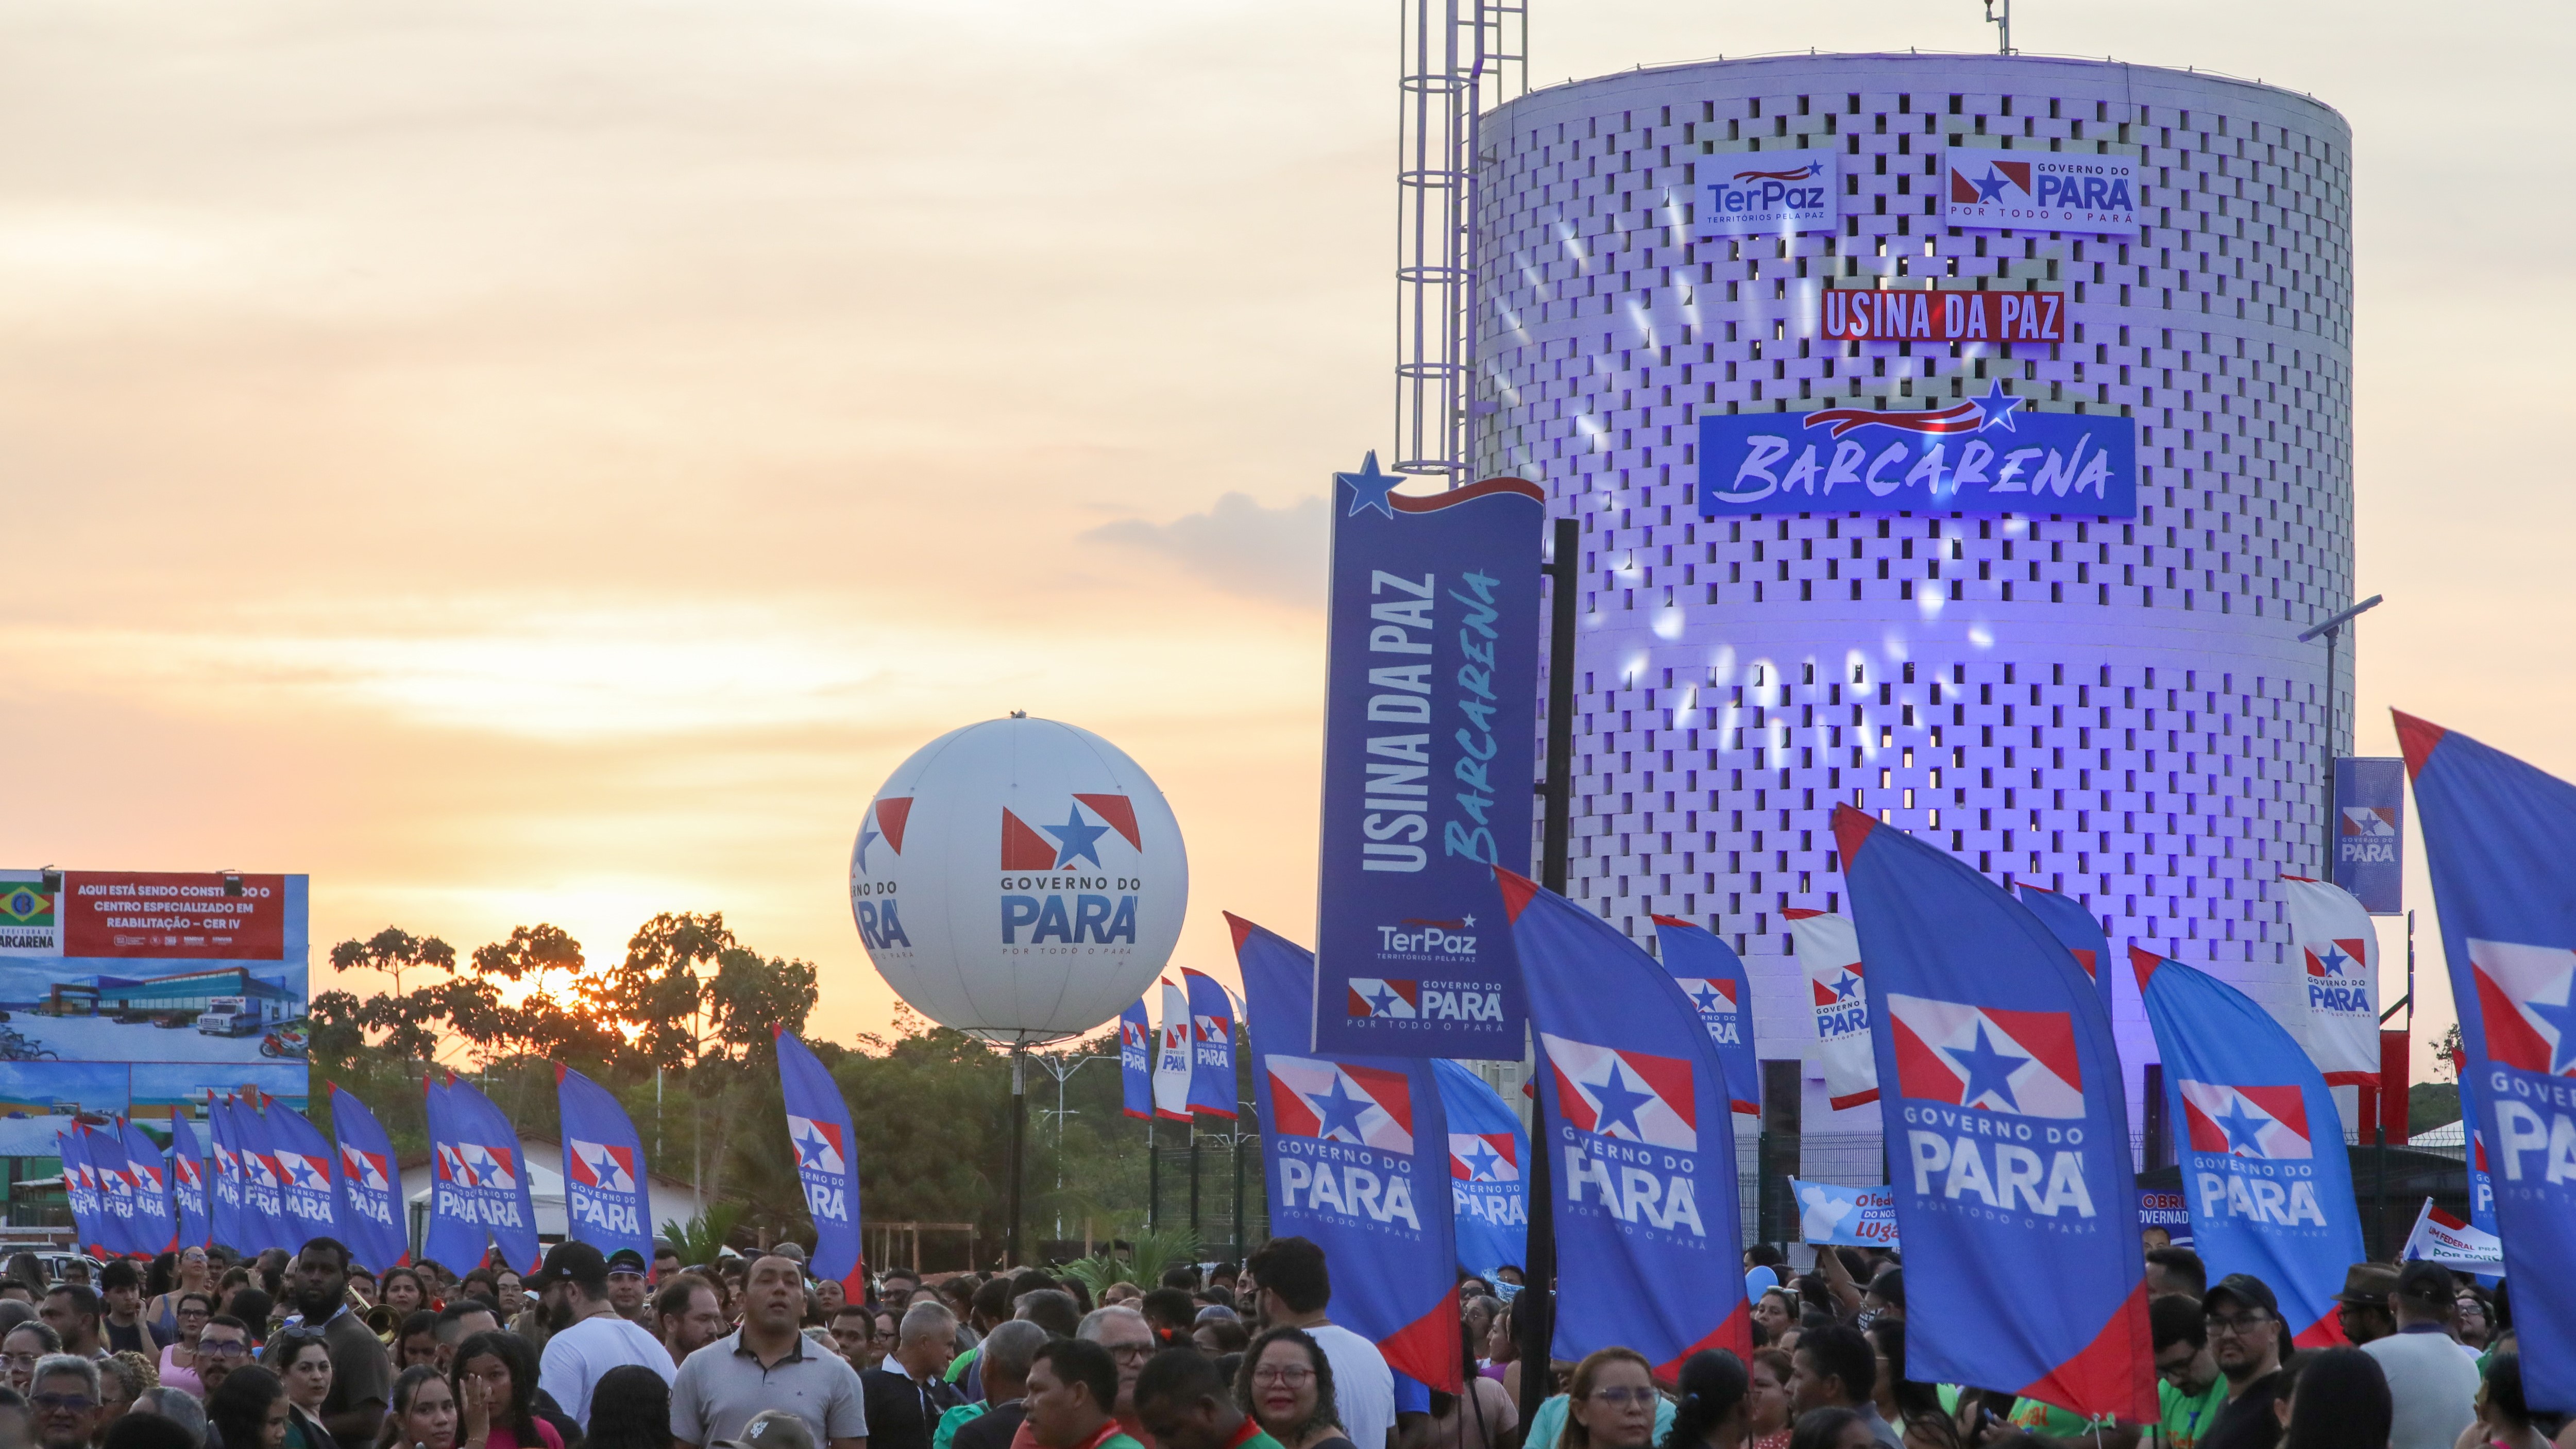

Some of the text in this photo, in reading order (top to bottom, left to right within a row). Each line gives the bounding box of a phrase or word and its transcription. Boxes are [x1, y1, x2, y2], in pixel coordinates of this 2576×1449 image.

[2038, 163, 2103, 174] GOVERNO
[1707, 181, 1824, 212] TerPaz
[2038, 175, 2133, 211] PARÁ
[1707, 214, 1771, 223] TERRITÓRIOS
[1951, 207, 1984, 215] POR
[2000, 209, 2048, 218] TODO
[2088, 213, 2132, 223] PARÁ
[1826, 292, 2059, 340] USINA DA PAZ
[1712, 433, 2114, 504] BARCARENA
[1363, 569, 1434, 872] USINA DA PAZ
[1445, 568, 1500, 881] BARCARENA
[78, 883, 270, 898] AQUI ESTÁ SENDO CONSTDO O
[877, 881, 896, 894] DO
[1001, 877, 1140, 890] GOVERNO DO
[94, 902, 253, 913] CENTRO ESPECIALIZADO EM
[107, 916, 241, 931] REABILITAÇÃO CER IV
[853, 899, 912, 950] RÁ
[1001, 895, 1138, 944] PARÁ
[1378, 926, 1476, 954] TerPaz
[1377, 953, 1432, 961] TERRITÓRIOS
[1423, 981, 1479, 990] GOVERNO
[2308, 976, 2347, 986] GOVERNO
[1422, 991, 1503, 1022] PARÁ
[1817, 1001, 1859, 1014] GOVERNO
[2308, 984, 2370, 1012] PARÁ
[1347, 1020, 1503, 1032] POR TODO O PARÁ
[1707, 1022, 1740, 1044] RÁ
[1904, 1106, 2083, 1144] GOVERNO DO
[1278, 1140, 1411, 1173] GOVERNO DO
[1563, 1126, 1694, 1173] GVERNO DO
[800, 1171, 844, 1186] ERNO DO
[1907, 1130, 2097, 1219] PARÁ
[2194, 1157, 2312, 1177] GOVERNO DO
[284, 1186, 314, 1197] VERNO
[571, 1183, 621, 1202] GOVERNO
[801, 1181, 848, 1221] RÁ
[1279, 1158, 1421, 1231] PARÁ
[1856, 1192, 1893, 1207] O Fed
[2197, 1172, 2327, 1227] PARÁ
[478, 1198, 522, 1228] ARÁ
[571, 1192, 640, 1235] PARÁ
[1569, 1206, 1598, 1217] POR
[1958, 1205, 2009, 1224] TODO
[2025, 1218, 2035, 1228] O
[1317, 1215, 1355, 1227] TODO
[1385, 1227, 1420, 1241] PARÁ
[2429, 1226, 2440, 1238] UM
[2439, 1232, 2475, 1250] FEDERAL
[2433, 1248, 2461, 1258] POR
